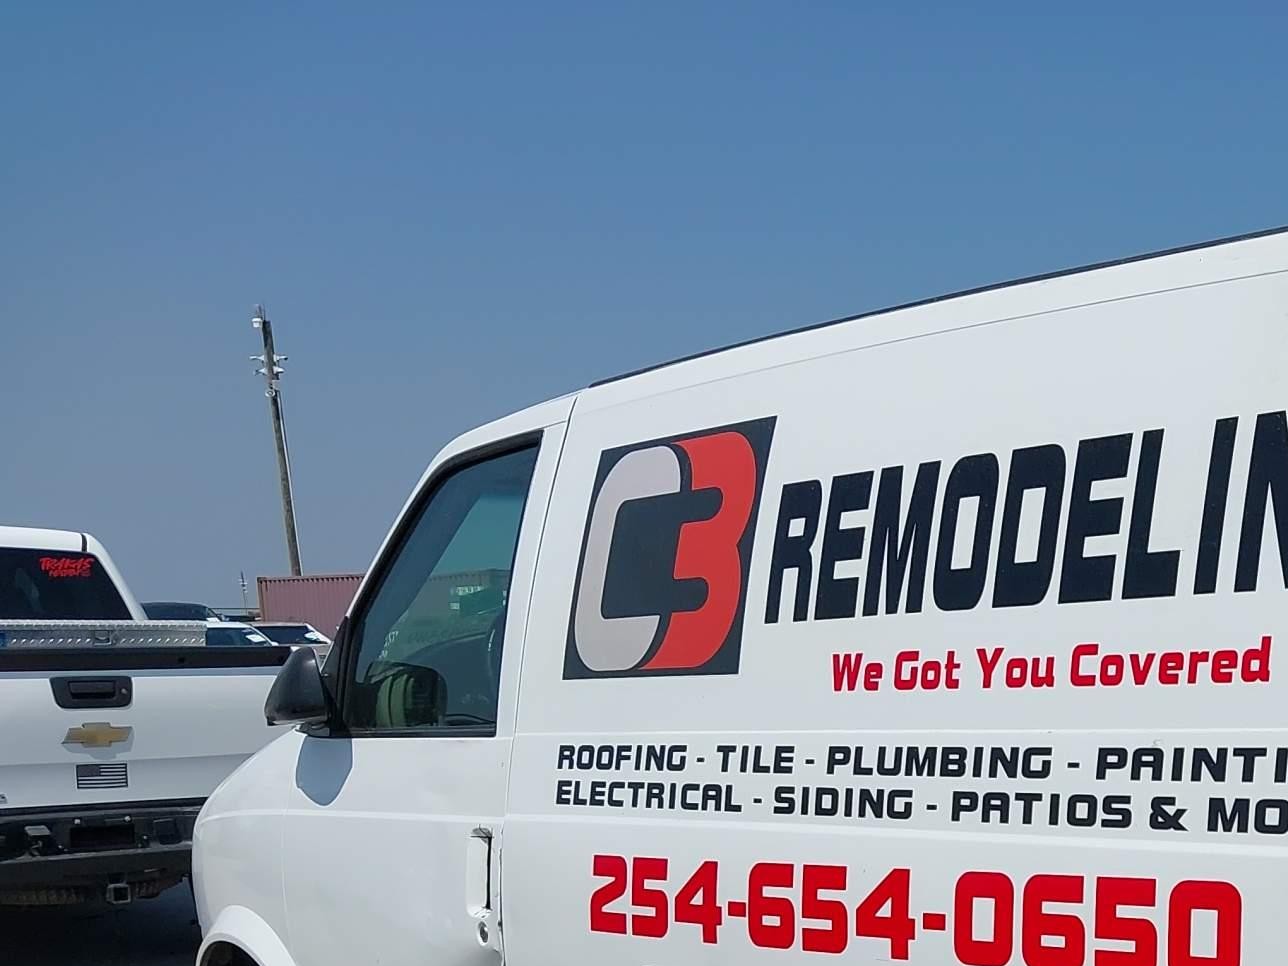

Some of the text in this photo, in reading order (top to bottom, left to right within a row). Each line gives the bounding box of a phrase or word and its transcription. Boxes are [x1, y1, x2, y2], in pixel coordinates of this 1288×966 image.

[574, 430, 758, 672] C3
[832, 635, 1272, 692] We Got You Covered
[557, 744, 688, 772] ROOFING
[716, 745, 795, 774] TILE
[826, 745, 1053, 779] PLUMBING
[555, 779, 743, 813] ELECTRICAL
[773, 785, 914, 820] SIDING
[951, 790, 1133, 829] PATIOS
[1149, 796, 1188, 832] &
